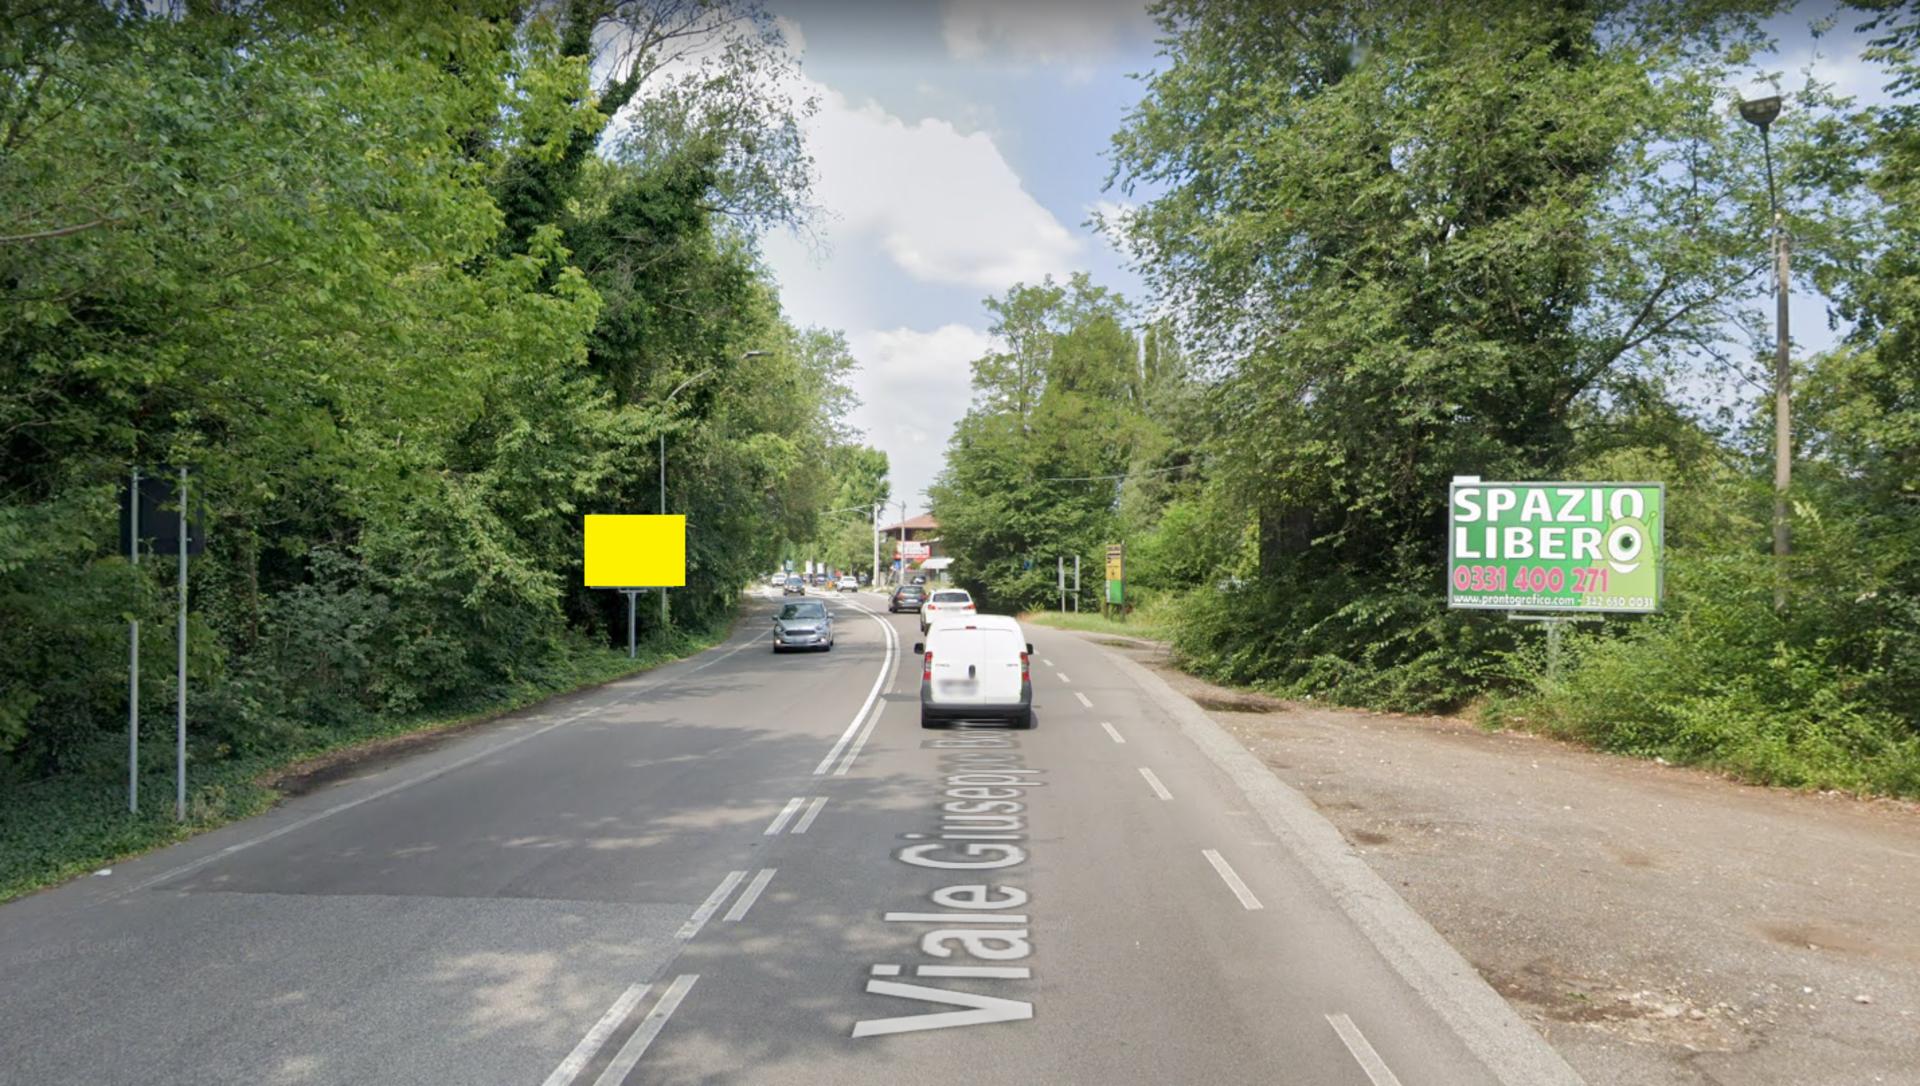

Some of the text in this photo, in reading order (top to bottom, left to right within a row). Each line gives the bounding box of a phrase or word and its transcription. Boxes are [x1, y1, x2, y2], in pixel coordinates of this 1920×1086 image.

[1453, 488, 1644, 523] SPAZIO
[1454, 526, 1643, 561] LIBERO
[1454, 565, 1609, 593] 0331 400 271
[1453, 594, 1575, 606] www.prontografica.com
